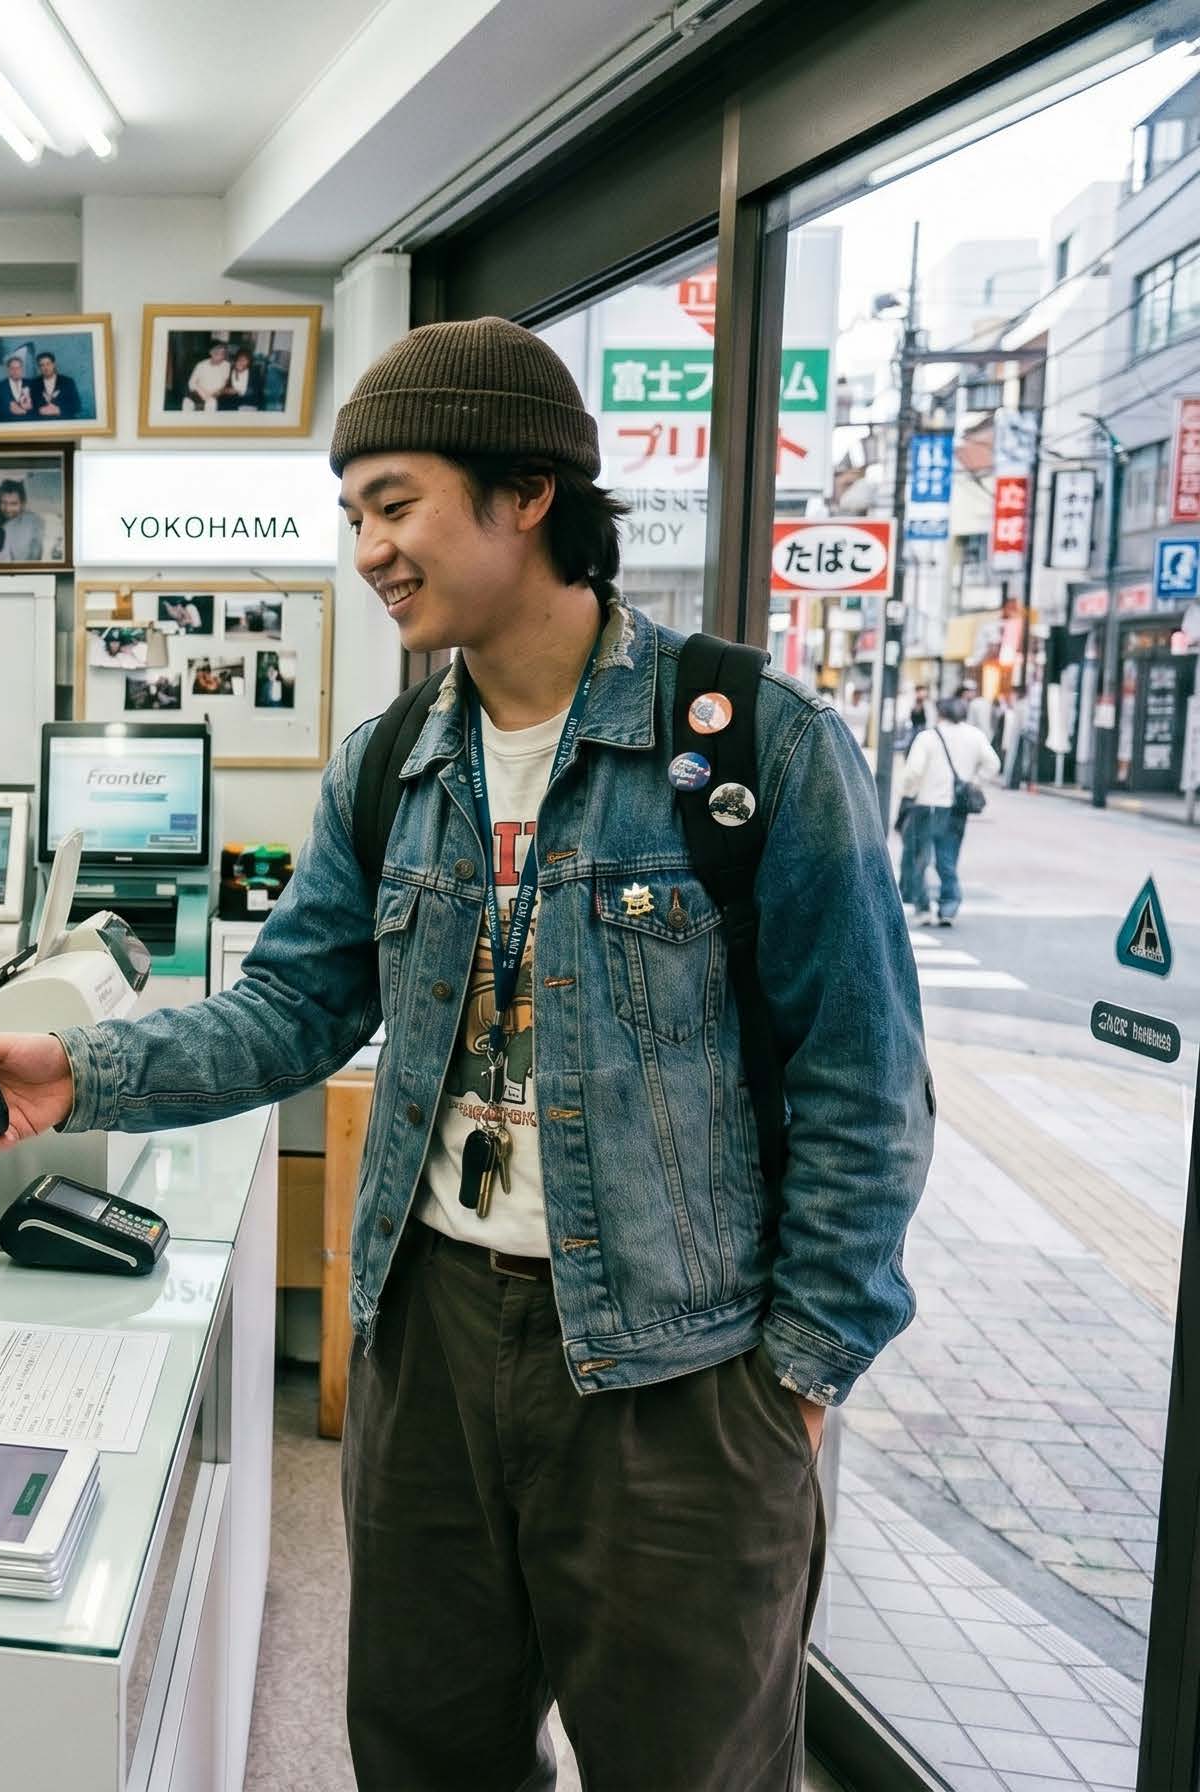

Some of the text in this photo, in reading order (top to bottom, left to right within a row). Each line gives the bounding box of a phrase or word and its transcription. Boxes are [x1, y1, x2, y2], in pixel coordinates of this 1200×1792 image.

[611, 360, 819, 403] 富士フム
[617, 422, 808, 476] プリト
[120, 516, 300, 538] YOKOHAMA
[785, 540, 873, 574] たばこ
